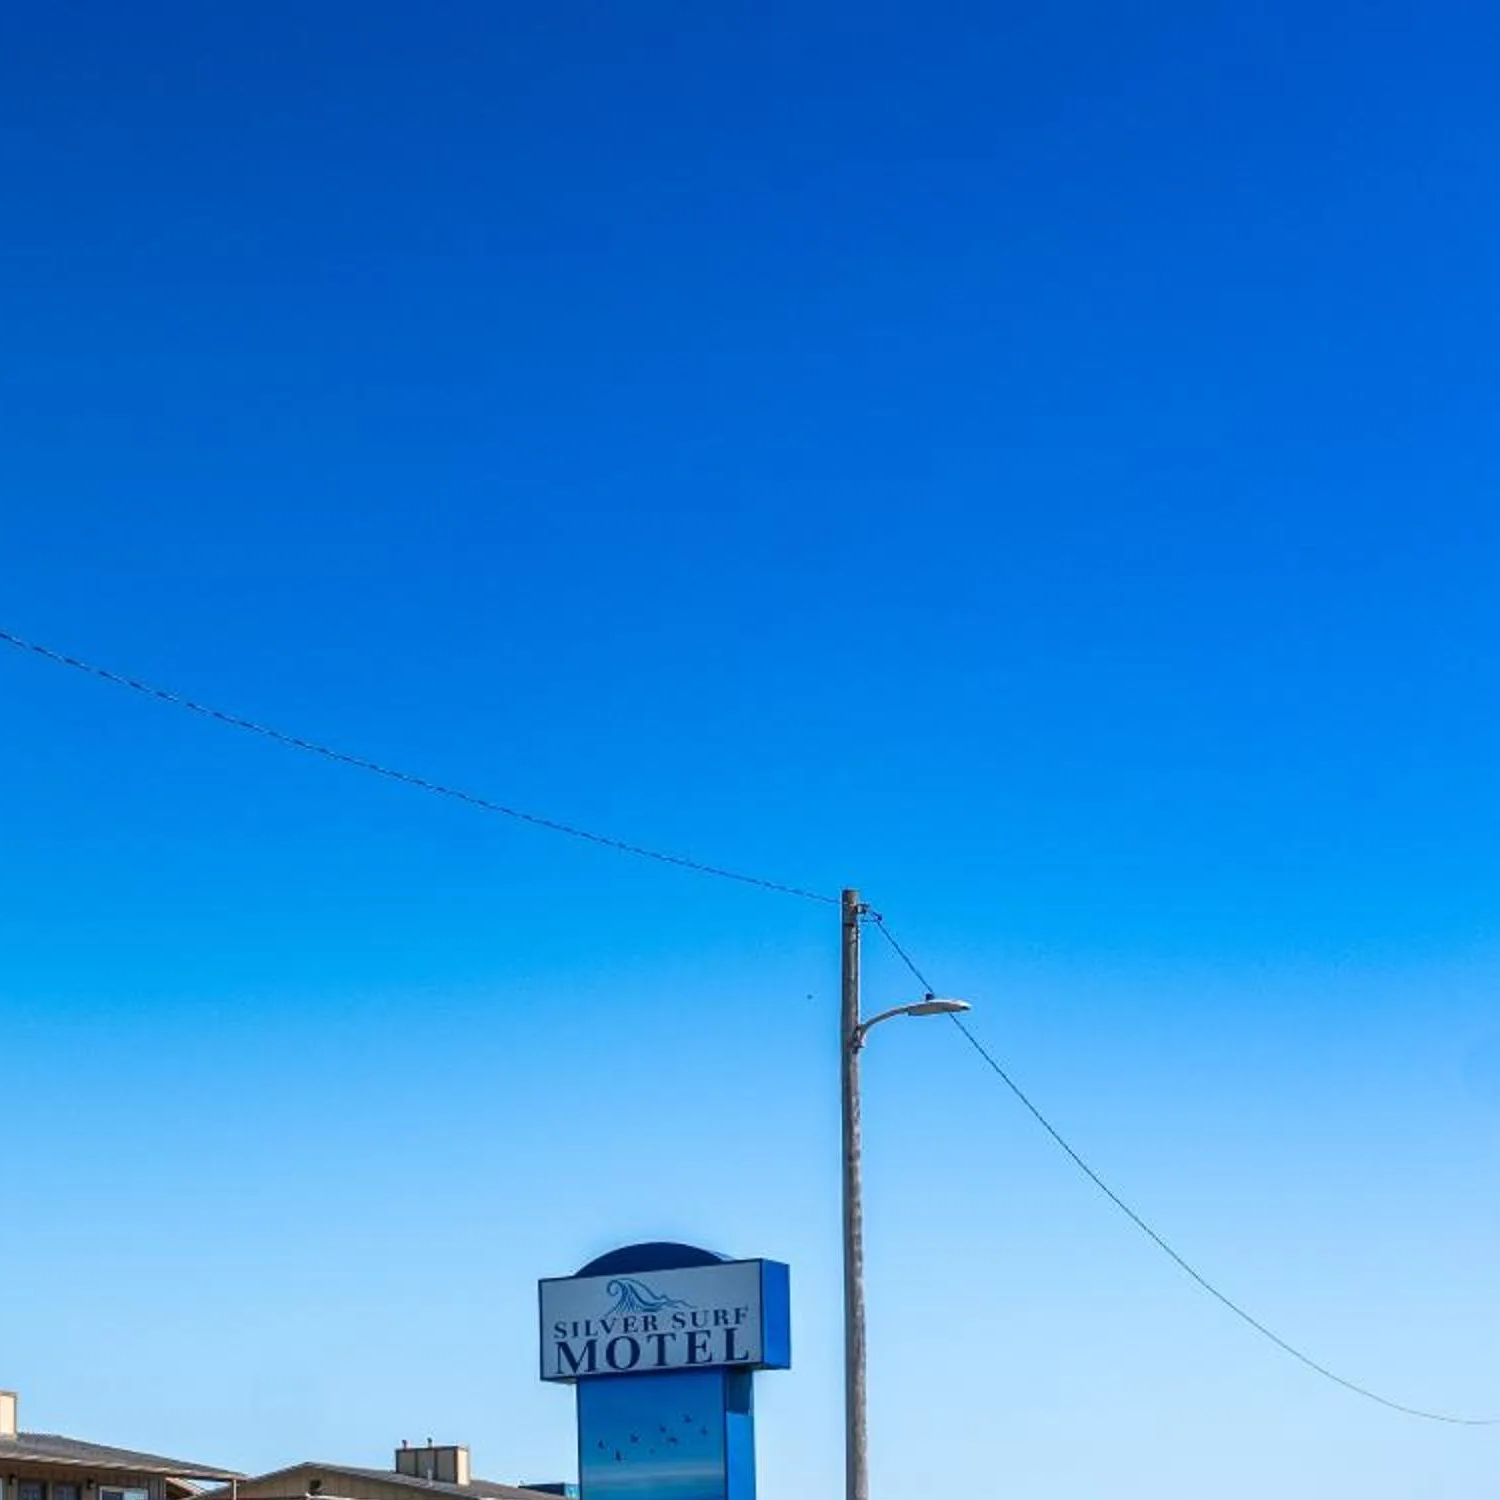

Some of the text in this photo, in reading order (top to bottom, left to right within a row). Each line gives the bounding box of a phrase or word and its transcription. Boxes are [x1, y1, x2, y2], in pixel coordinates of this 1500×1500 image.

[553, 1305, 749, 1339] SILVER SURF
[555, 1327, 749, 1375] MOTEL
